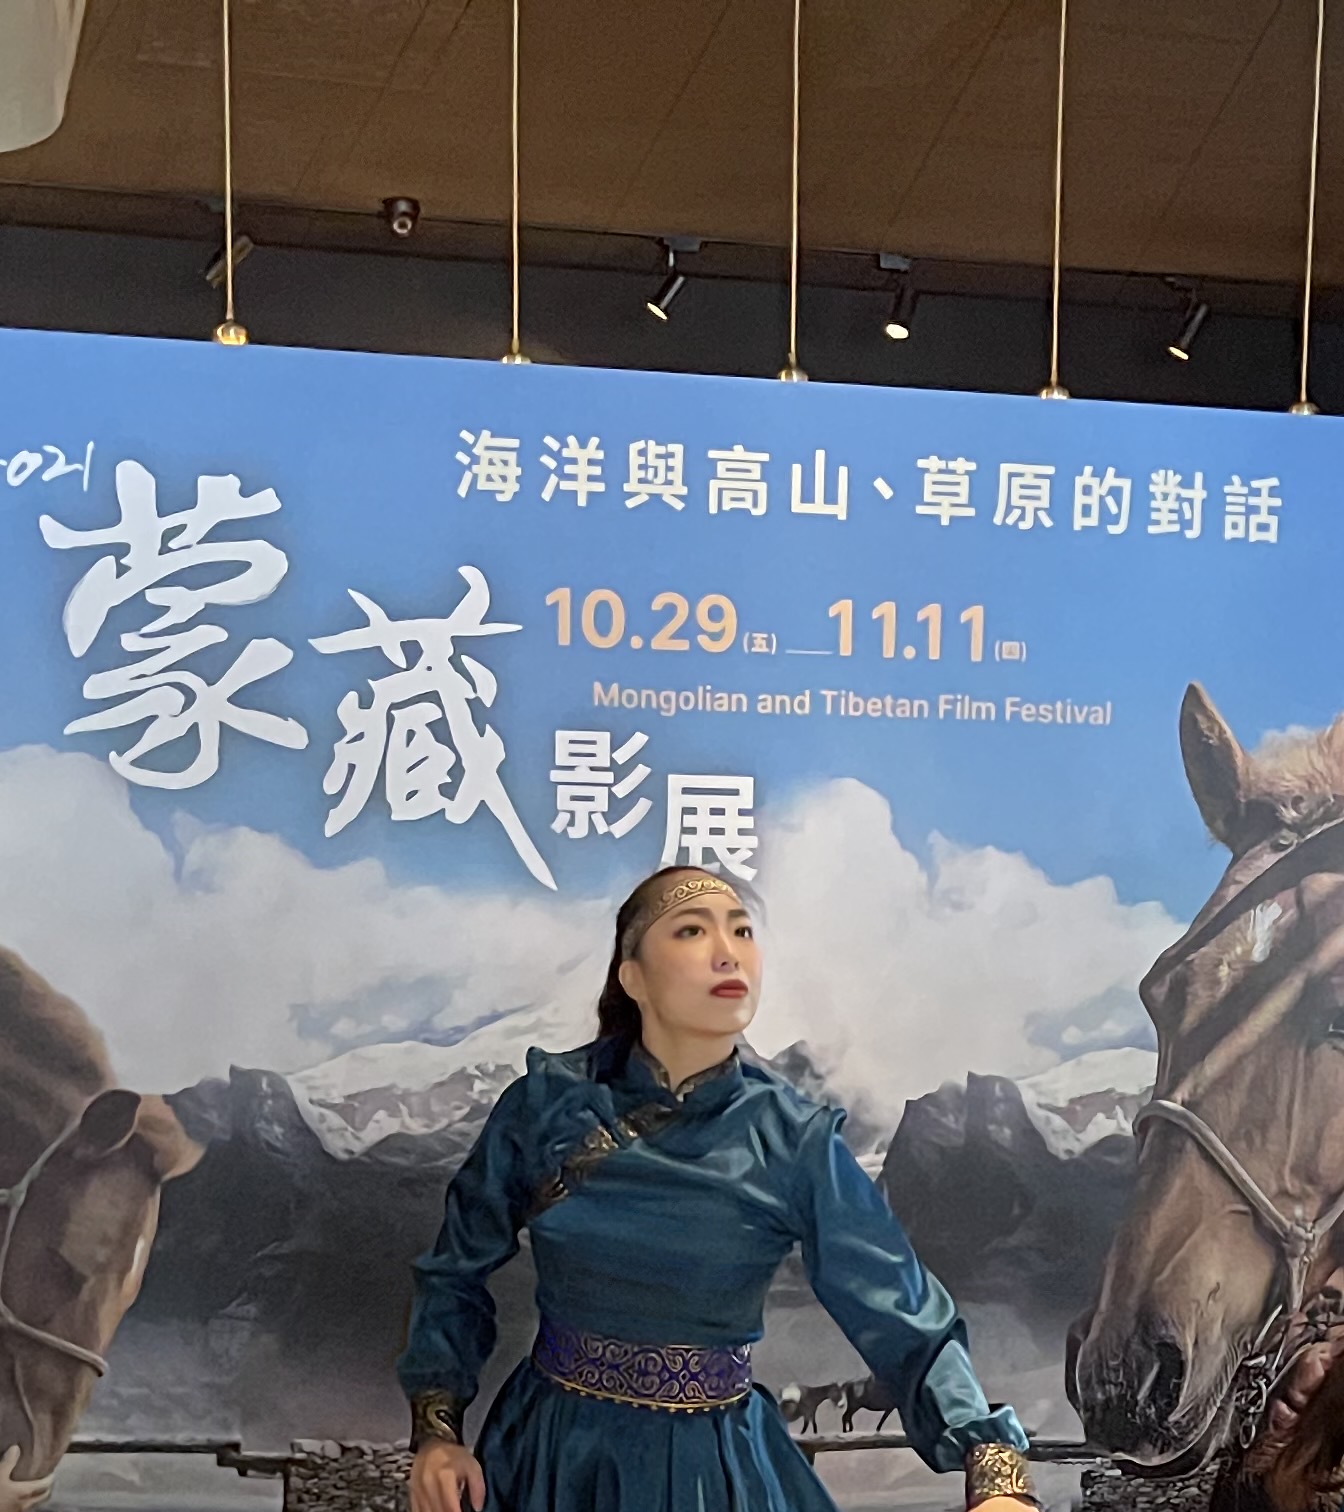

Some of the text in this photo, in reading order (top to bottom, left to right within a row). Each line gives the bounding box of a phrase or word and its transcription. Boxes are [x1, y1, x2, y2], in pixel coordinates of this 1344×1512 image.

[455, 428, 1284, 545] 海洋與高山、草原的對話
[592, 681, 1112, 726] Mongolian and Tibetan Film Festival
